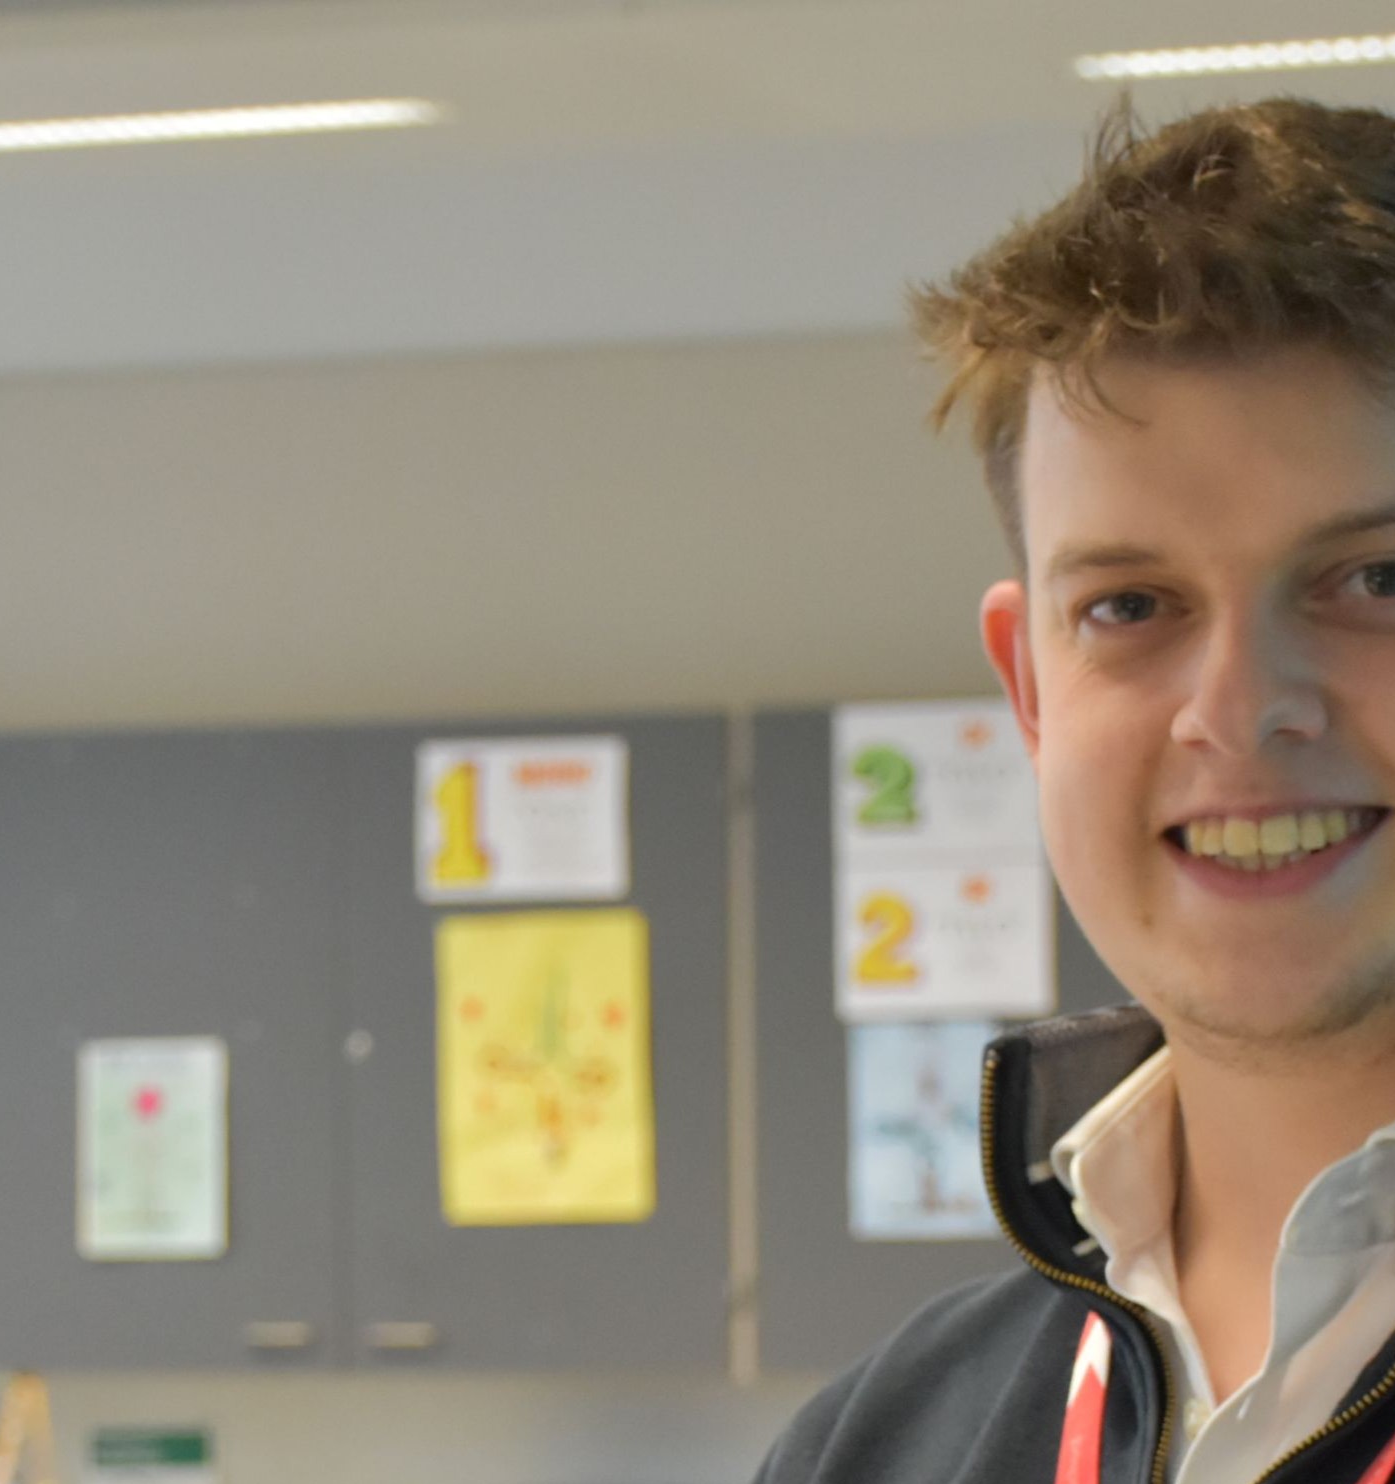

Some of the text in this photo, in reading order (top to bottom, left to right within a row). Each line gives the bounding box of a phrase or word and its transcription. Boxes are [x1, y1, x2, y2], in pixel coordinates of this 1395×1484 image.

[428, 757, 493, 888] 1
[850, 742, 919, 828] 2
[850, 890, 919, 988] 2
